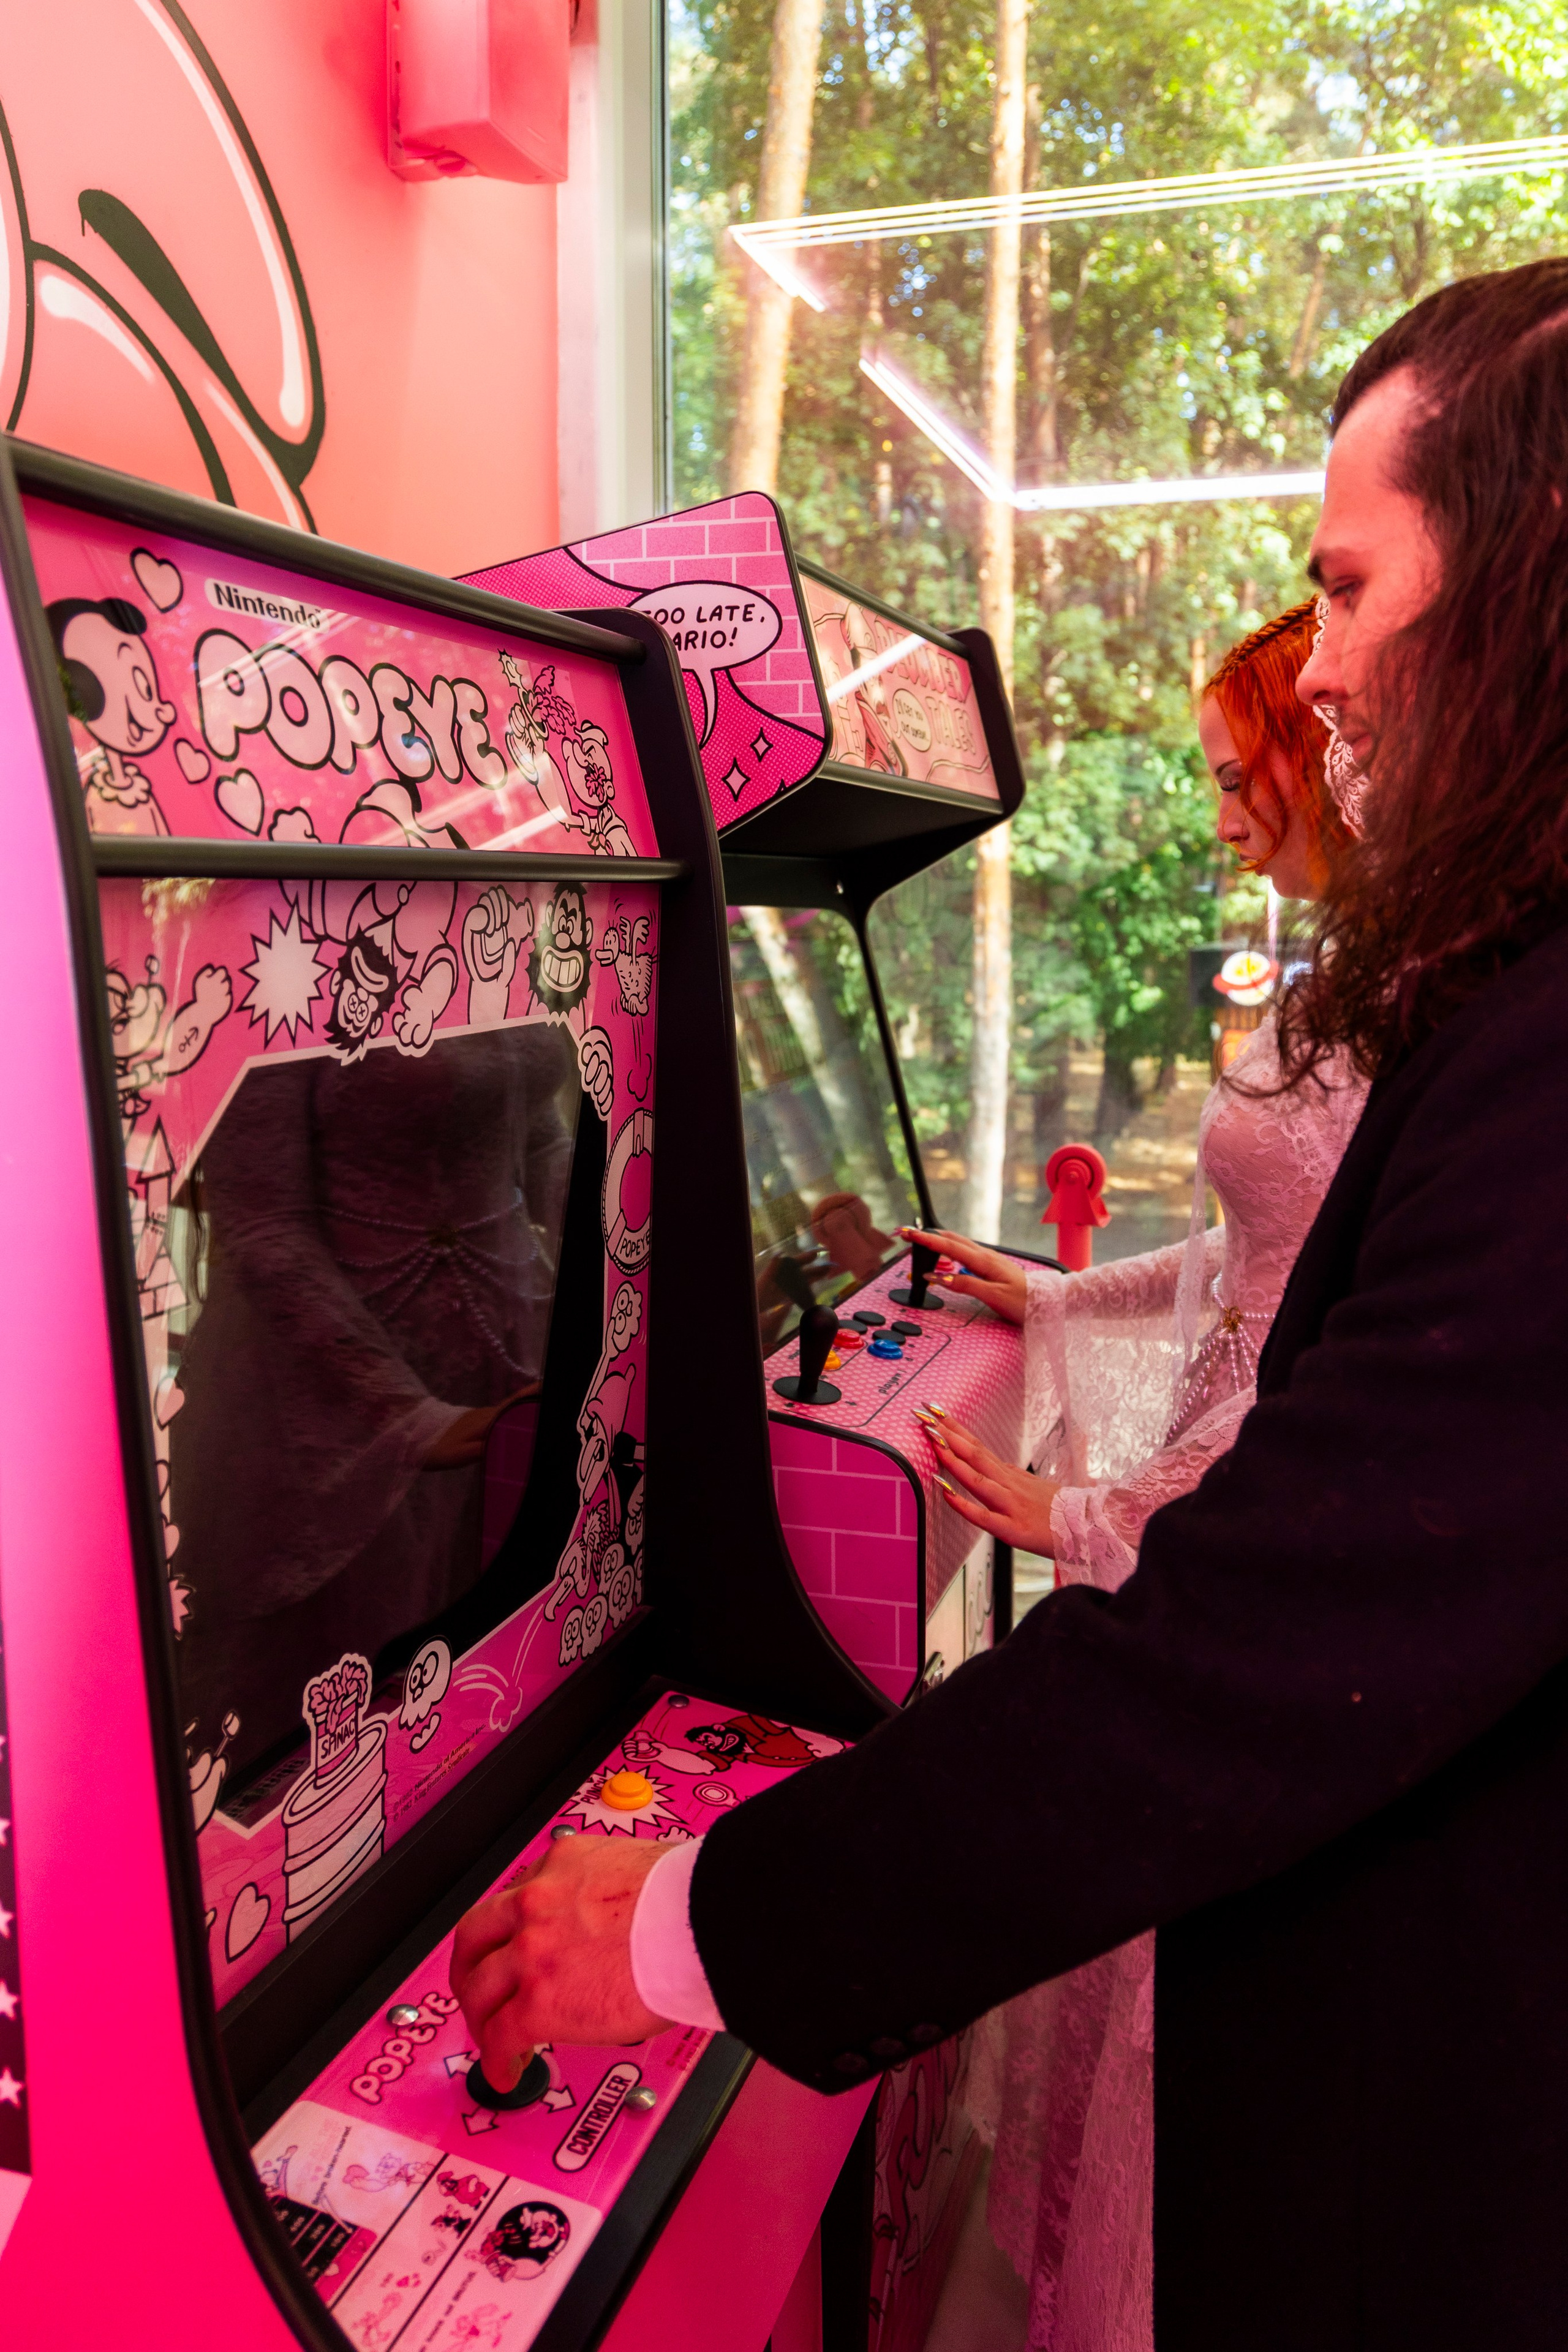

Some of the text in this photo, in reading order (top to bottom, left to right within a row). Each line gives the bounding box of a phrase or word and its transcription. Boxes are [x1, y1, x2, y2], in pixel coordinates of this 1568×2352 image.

[696, 603, 765, 623] LATE,
[194, 628, 508, 790] POPEYE
[620, 1228, 650, 1258] POPEYE
[415, 1763, 443, 1791] Nintendo
[443, 1754, 450, 1764] of
[450, 1733, 475, 1758] America
[349, 1991, 461, 2105] POPEYE
[566, 2075, 632, 2155] CONTROLLER
